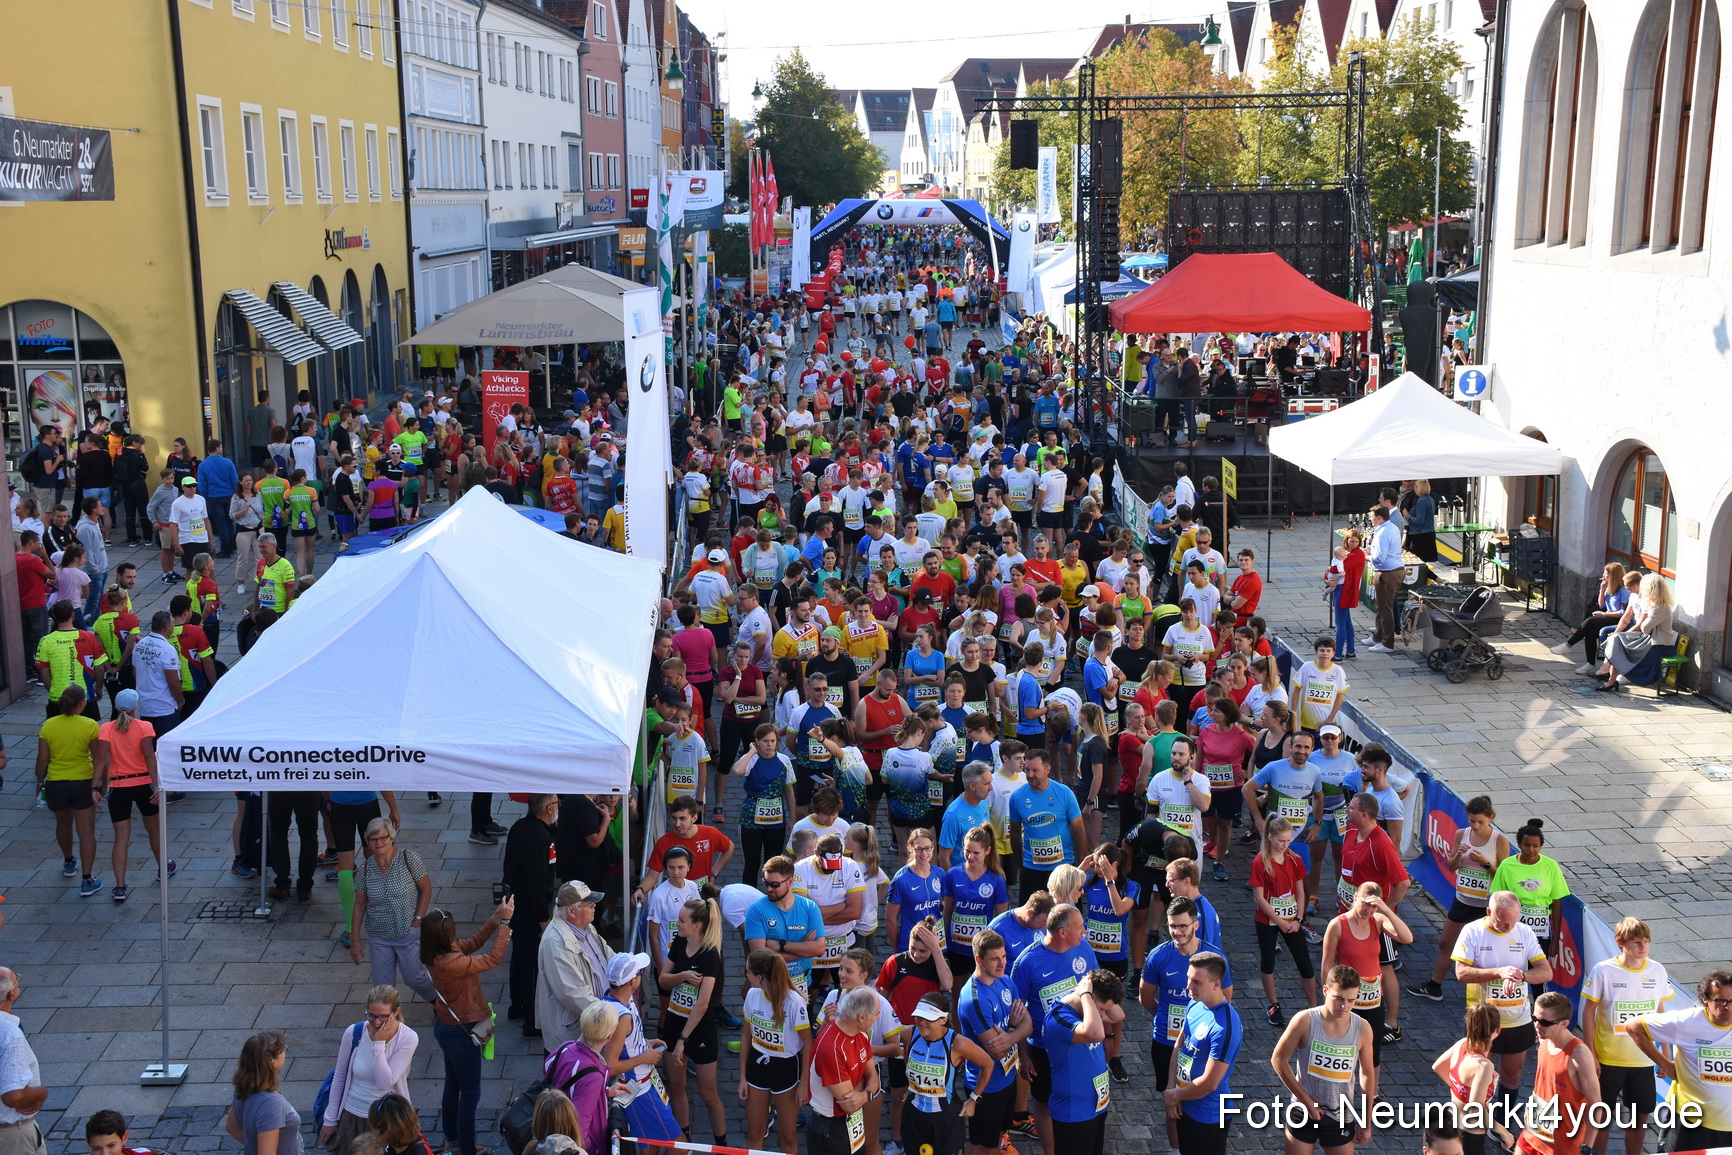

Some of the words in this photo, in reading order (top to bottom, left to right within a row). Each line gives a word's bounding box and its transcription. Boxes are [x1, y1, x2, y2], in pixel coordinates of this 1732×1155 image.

[78, 137, 96, 170] 28.
[0, 161, 74, 190] KULTURNACHT
[586, 203, 609, 214] sutor
[826, 215, 851, 235] NEUMARKT
[26, 318, 55, 337] FOTO
[495, 322, 564, 331] Neumarkter
[478, 328, 574, 340] Lammsbräu
[491, 375, 519, 385] Viking
[485, 384, 526, 393] Athletics
[1225, 478, 1234, 491] RUN
[851, 636, 865, 644] MAX
[917, 688, 937, 697] 5226
[1121, 687, 1136, 696] 523
[1309, 689, 1331, 699] 5227
[180, 745, 243, 763] BMW
[247, 745, 427, 764] ConnectedDrive
[181, 767, 253, 783] Vernetzt,
[256, 769, 280, 780] um
[283, 767, 309, 780] frei
[312, 769, 331, 780] zu
[333, 767, 371, 780] sein.
[671, 774, 692, 784] 5286
[1208, 773, 1230, 781] 5219
[758, 807, 781, 817] 5208
[1164, 803, 1194, 813] BOCK
[1281, 807, 1305, 817] 5135
[1166, 812, 1190, 823] 5240
[1033, 847, 1060, 857] 5094
[1459, 876, 1485, 890] 5284
[914, 899, 941, 912] #LÄUFT
[955, 901, 987, 911] #LÄUFT
[1089, 904, 1115, 915] #LÄUF
[953, 914, 988, 925] BOCK
[1520, 915, 1547, 927] 4009
[1088, 919, 1121, 932] BOCK
[1089, 931, 1118, 944] 5082
[815, 958, 841, 966] MATTHIA
[1040, 977, 1077, 997] BOCK
[672, 991, 694, 1007] 5259
[1617, 1002, 1652, 1011] BOCK
[753, 1026, 781, 1044] 5003
[756, 1038, 778, 1051] LUCIANA
[1315, 1042, 1352, 1057] BOCK
[1702, 1048, 1732, 1058] BOC
[908, 1060, 941, 1075] BOCK
[1313, 1054, 1350, 1071] 5266
[909, 1071, 940, 1087] 5141
